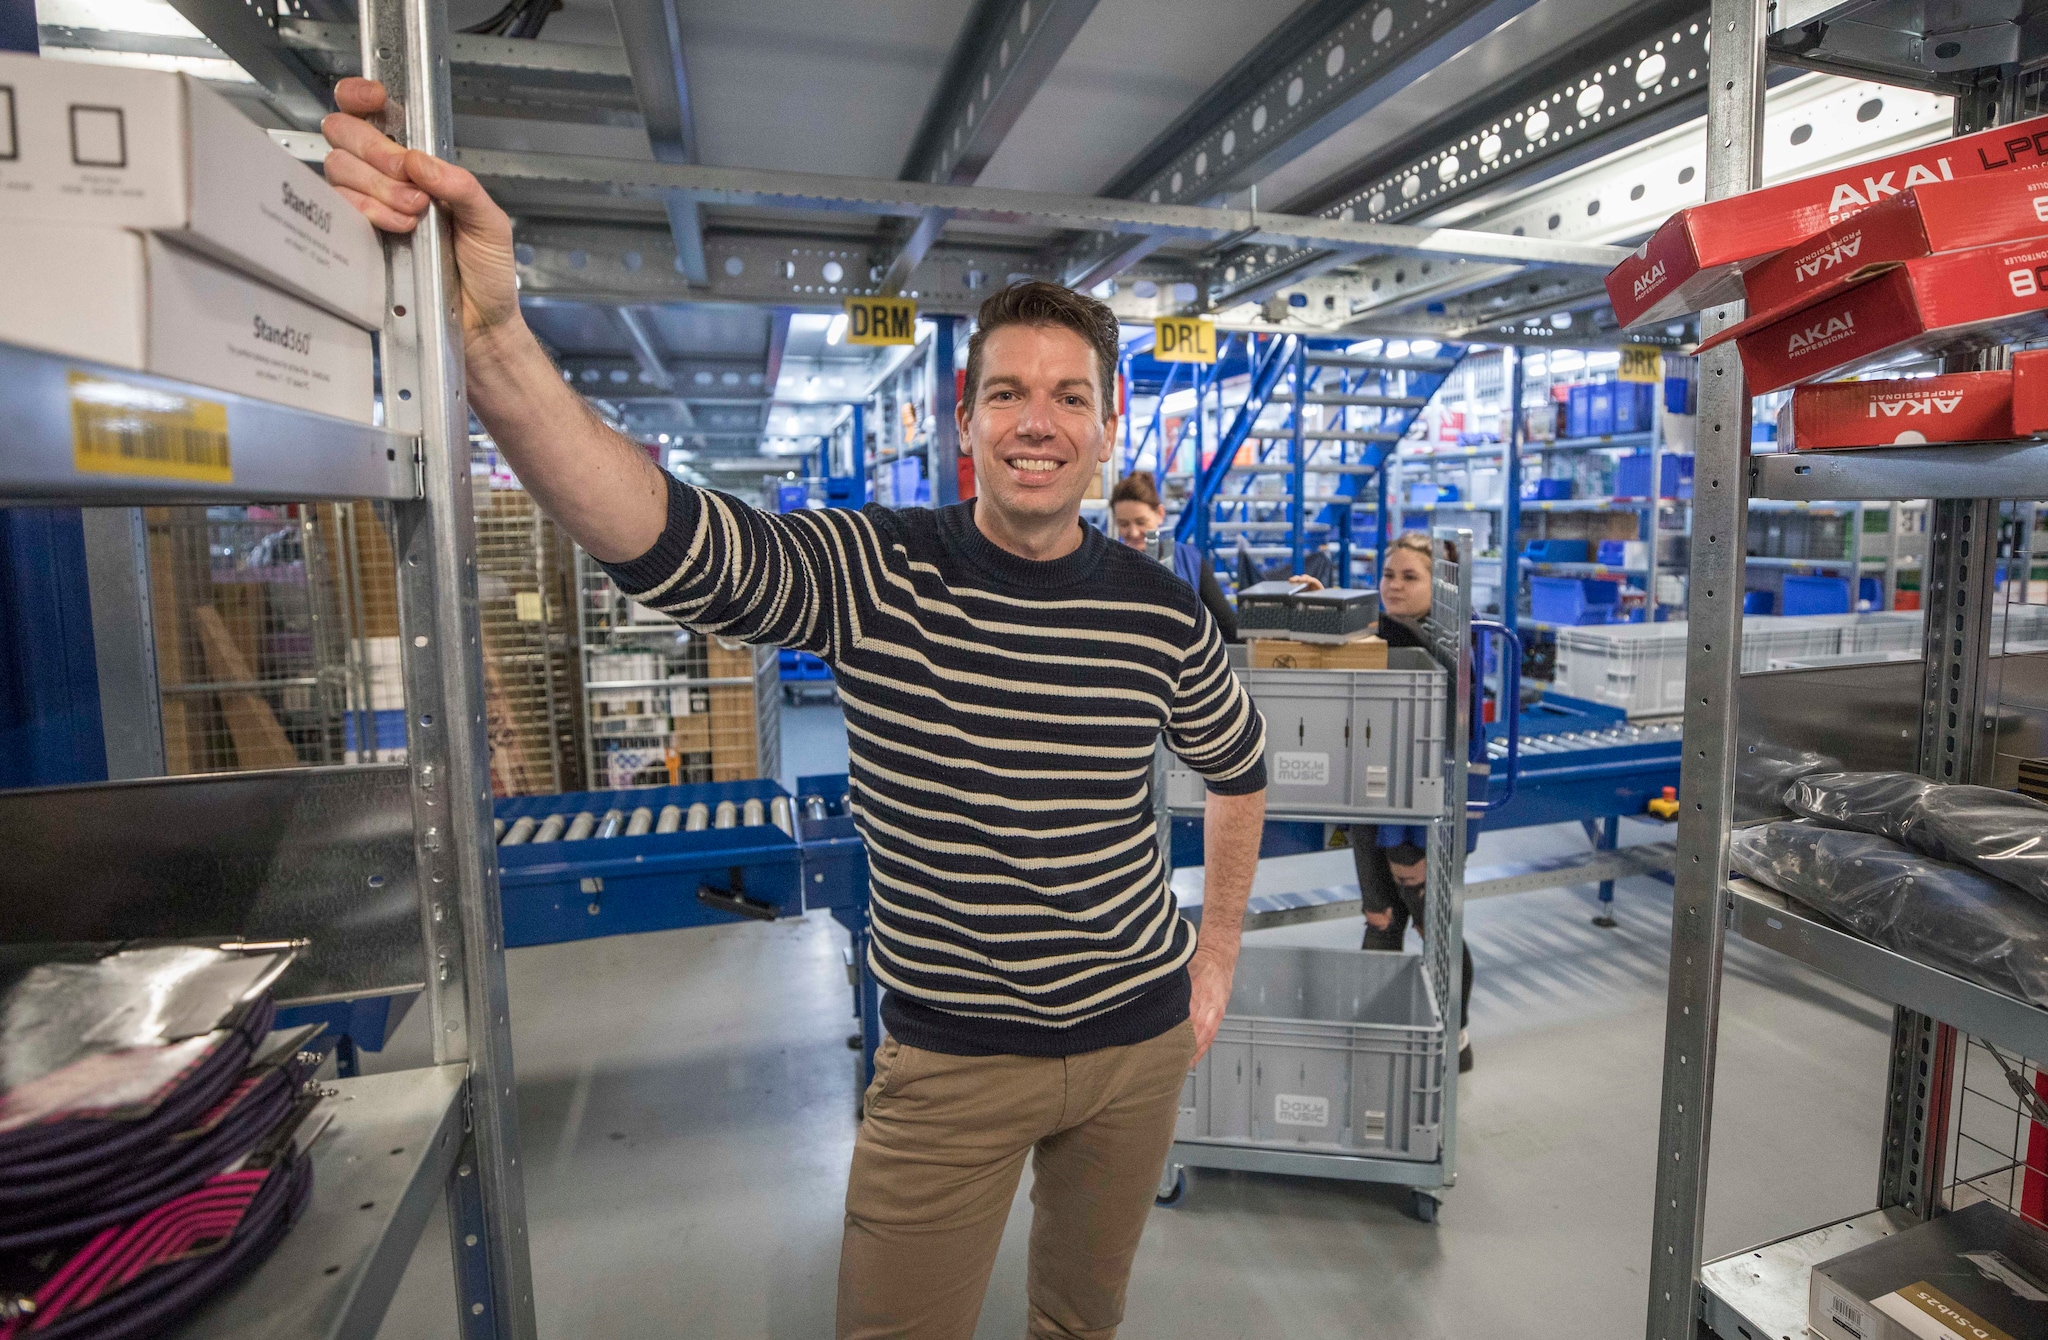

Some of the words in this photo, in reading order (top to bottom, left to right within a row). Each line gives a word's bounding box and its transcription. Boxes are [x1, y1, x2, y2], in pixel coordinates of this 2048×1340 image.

[1828, 158, 1954, 214] AKAI
[282, 181, 333, 234] Stand360
[1794, 229, 1862, 266] PROFESSIONAL
[1795, 236, 1862, 282] AKAI
[1634, 260, 1666, 297] AKAI
[1635, 275, 1668, 303] PROFESSIONAL
[253, 315, 311, 355] Stand360
[852, 303, 911, 338] DRM
[1161, 321, 1207, 354] DRL
[1788, 311, 1855, 353] AKAI
[1622, 349, 1658, 376] DRK
[1789, 329, 1856, 360] PROFESSIONAL
[1869, 396, 1963, 418] AKAI
[1870, 390, 1964, 401] PROFESSIONAL
[1917, 1291, 1989, 1339] D-Sub25
